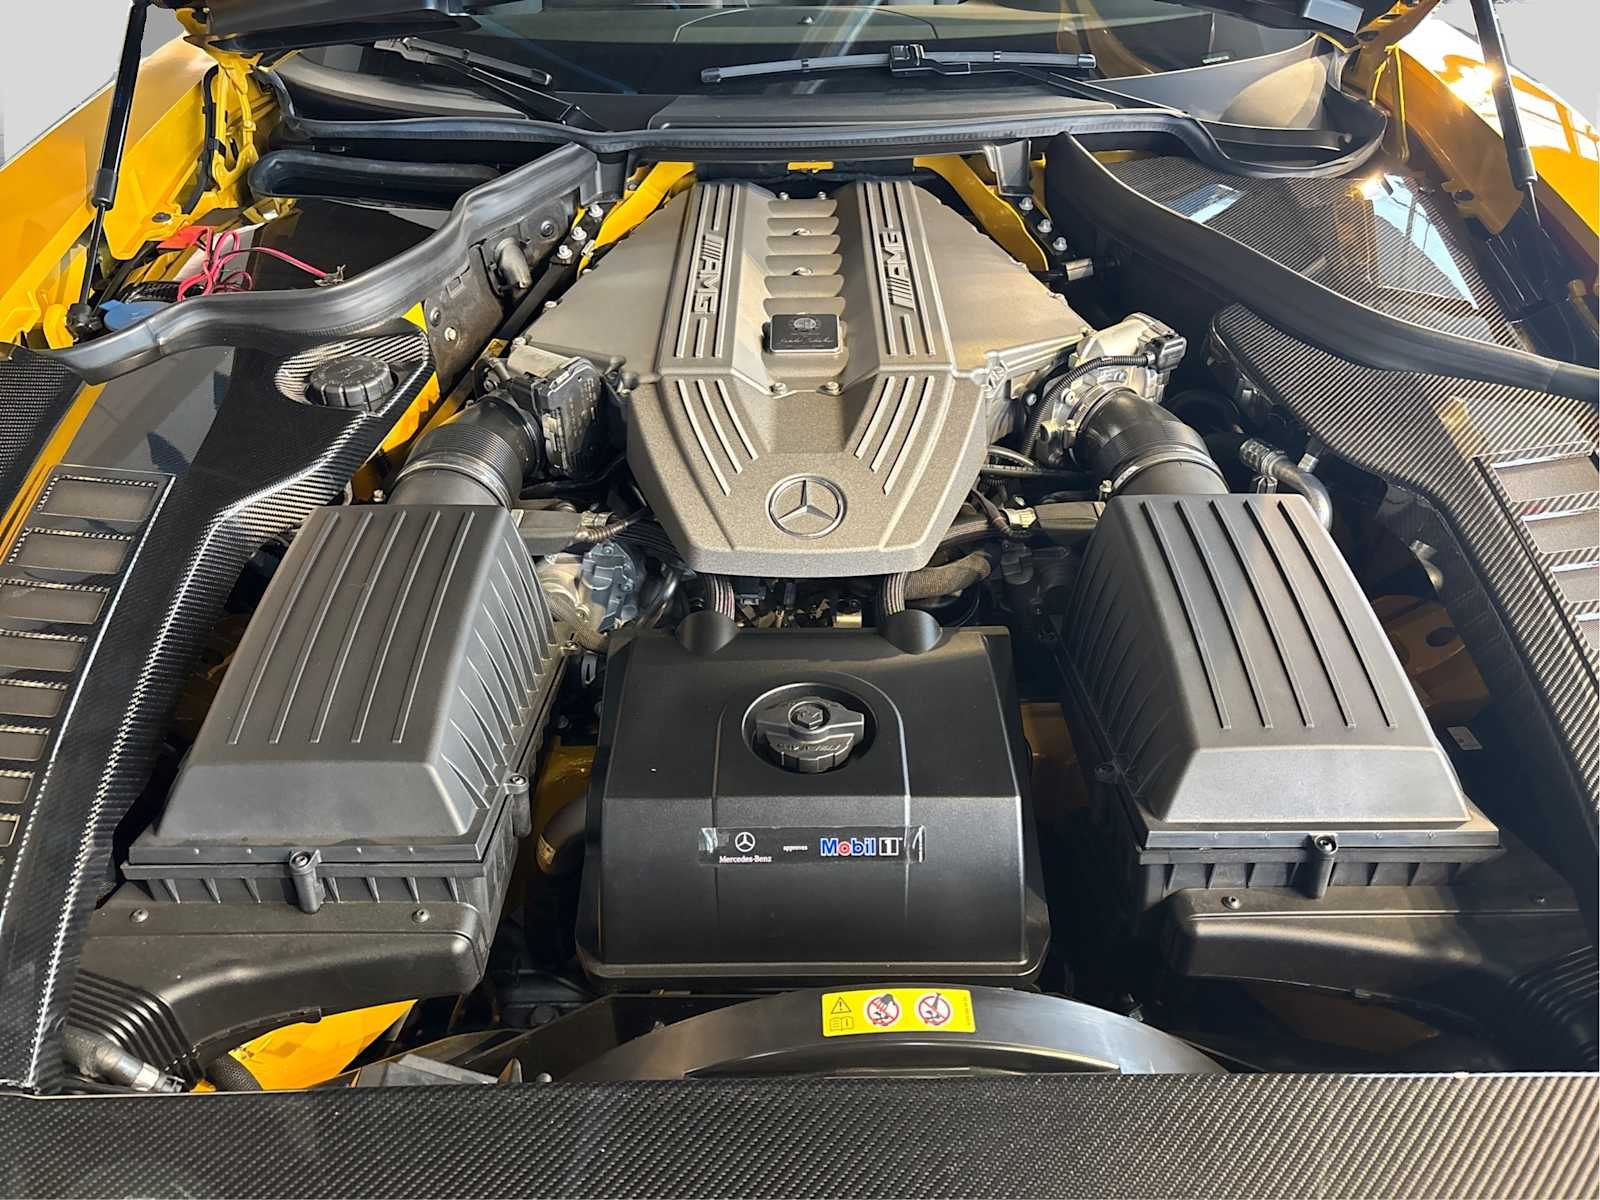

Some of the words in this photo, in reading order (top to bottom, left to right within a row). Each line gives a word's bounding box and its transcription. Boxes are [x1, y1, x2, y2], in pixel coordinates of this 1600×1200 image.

[881, 231, 909, 281] AMG
[694, 256, 723, 314] AMG
[719, 855, 772, 864] Mercedes-Benz
[820, 837, 877, 856] Mobil
[879, 837, 899, 856] 1
